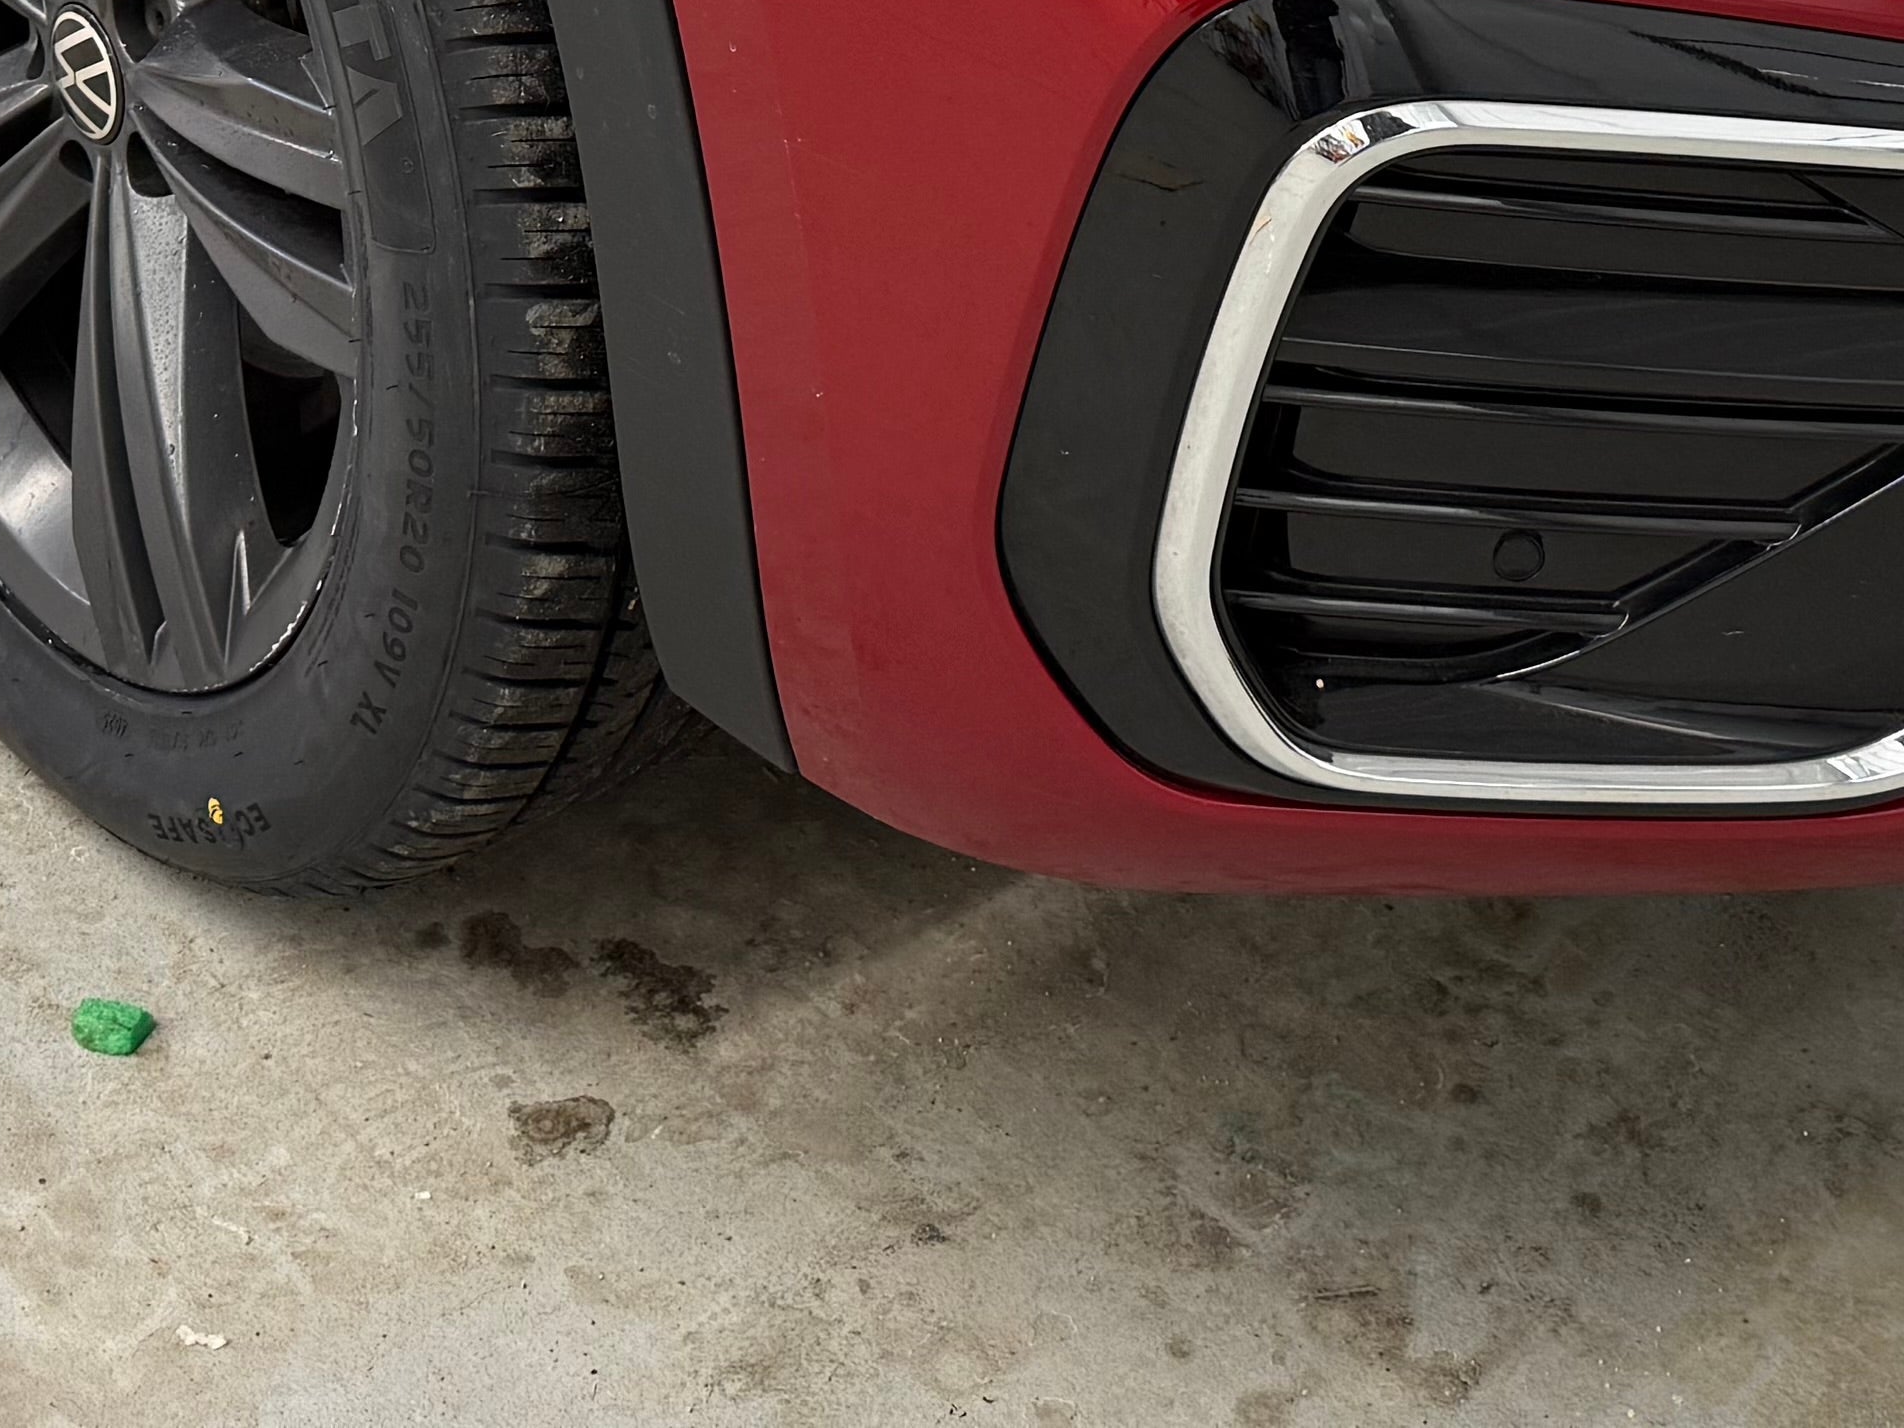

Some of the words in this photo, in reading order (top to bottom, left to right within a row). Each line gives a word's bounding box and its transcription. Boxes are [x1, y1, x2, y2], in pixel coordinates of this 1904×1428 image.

[398, 281, 435, 574] 255/50R20
[373, 587, 419, 688] 109V
[349, 690, 387, 735] XL
[147, 803, 272, 844] ECSAFE
